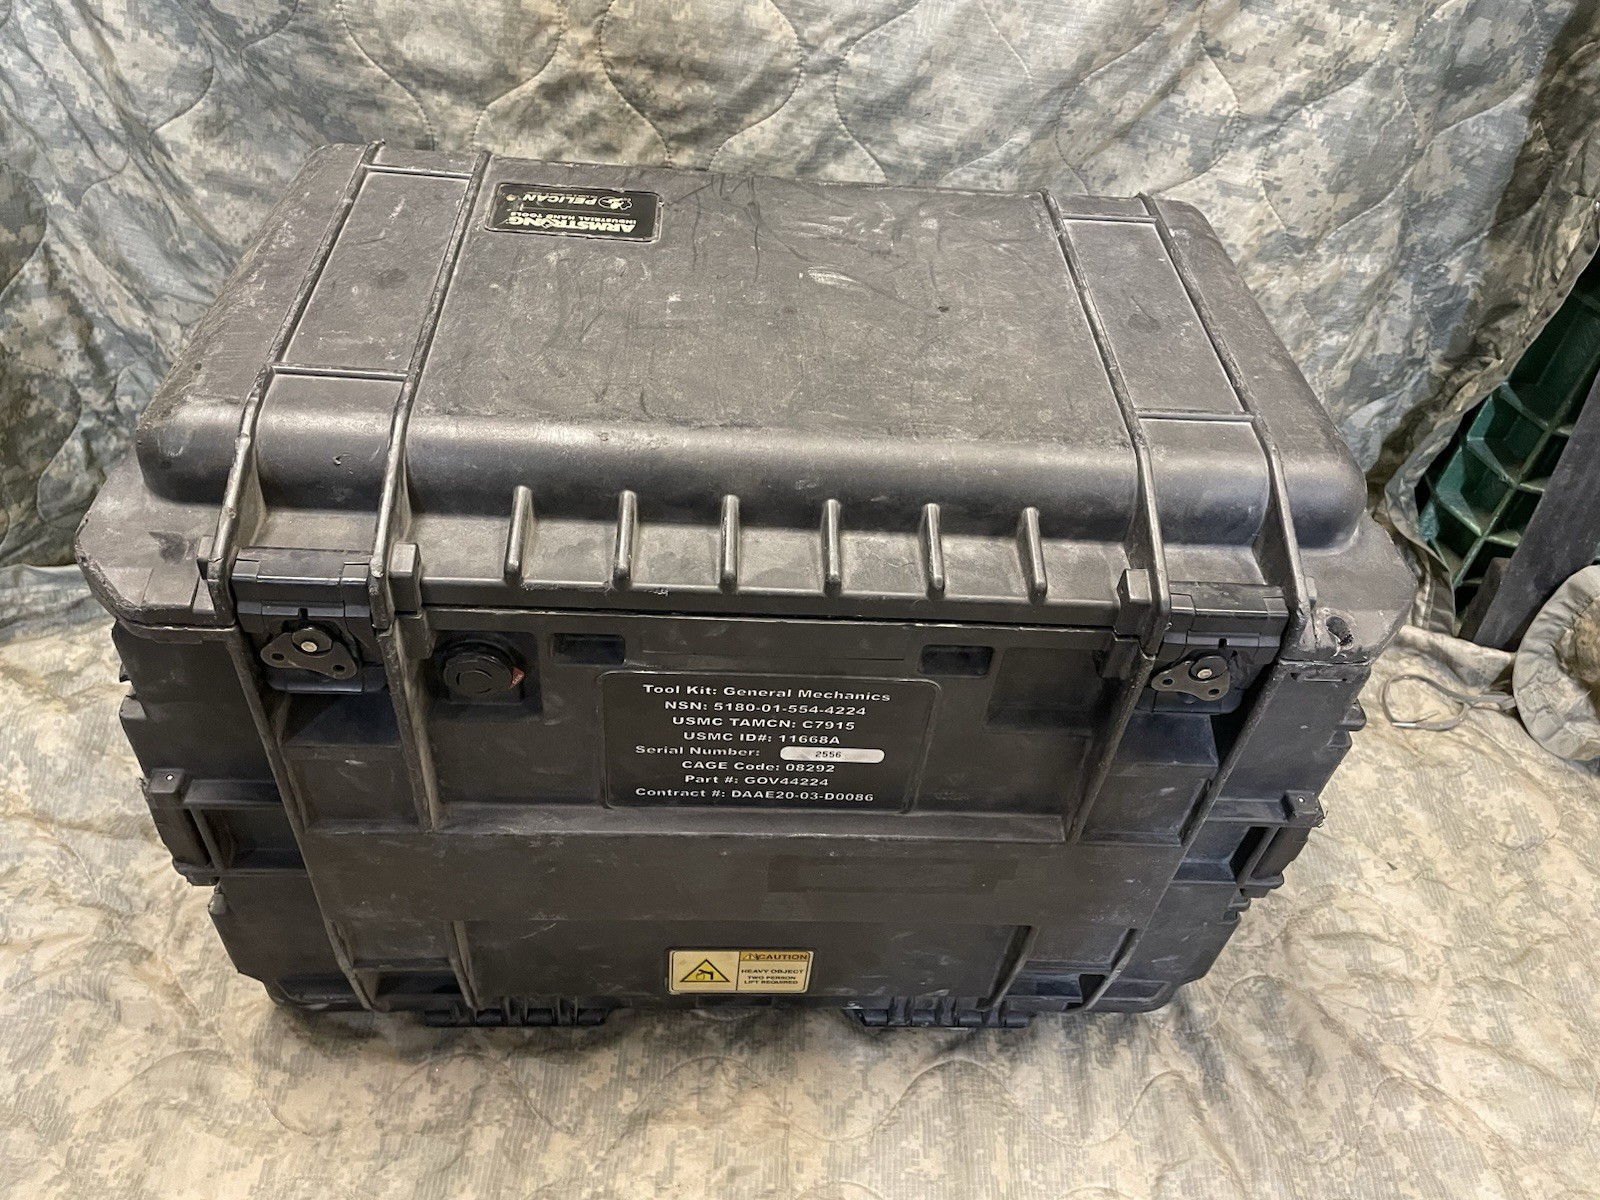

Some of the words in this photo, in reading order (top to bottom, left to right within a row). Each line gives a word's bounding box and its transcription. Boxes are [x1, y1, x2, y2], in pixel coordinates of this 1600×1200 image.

[523, 193, 597, 206] PELICAN
[578, 216, 636, 225] INDUSTRIAL
[643, 685, 679, 693] Tool
[687, 686, 716, 694] Kit:
[724, 687, 791, 697] General
[798, 690, 890, 701] Mechanics
[665, 701, 707, 710] NSN:
[714, 703, 865, 715] 5180-01-554-4224
[673, 717, 722, 726] USMC
[729, 718, 795, 728] TAMCN:
[803, 721, 854, 730] C7915
[684, 732, 732, 741] USMC
[740, 734, 771, 742] ID#:
[779, 735, 839, 744] 11668A
[635, 745, 683, 754] Serial
[688, 746, 760, 756] Number:
[815, 750, 842, 758] 2556
[682, 761, 727, 769] CAGE
[734, 762, 779, 771] Code:
[786, 764, 834, 772] 08292
[685, 775, 718, 783] Part
[745, 777, 828, 786] GOV44224
[636, 788, 705, 796] Contract
[732, 790, 873, 801] DAAE20-03-D0086
